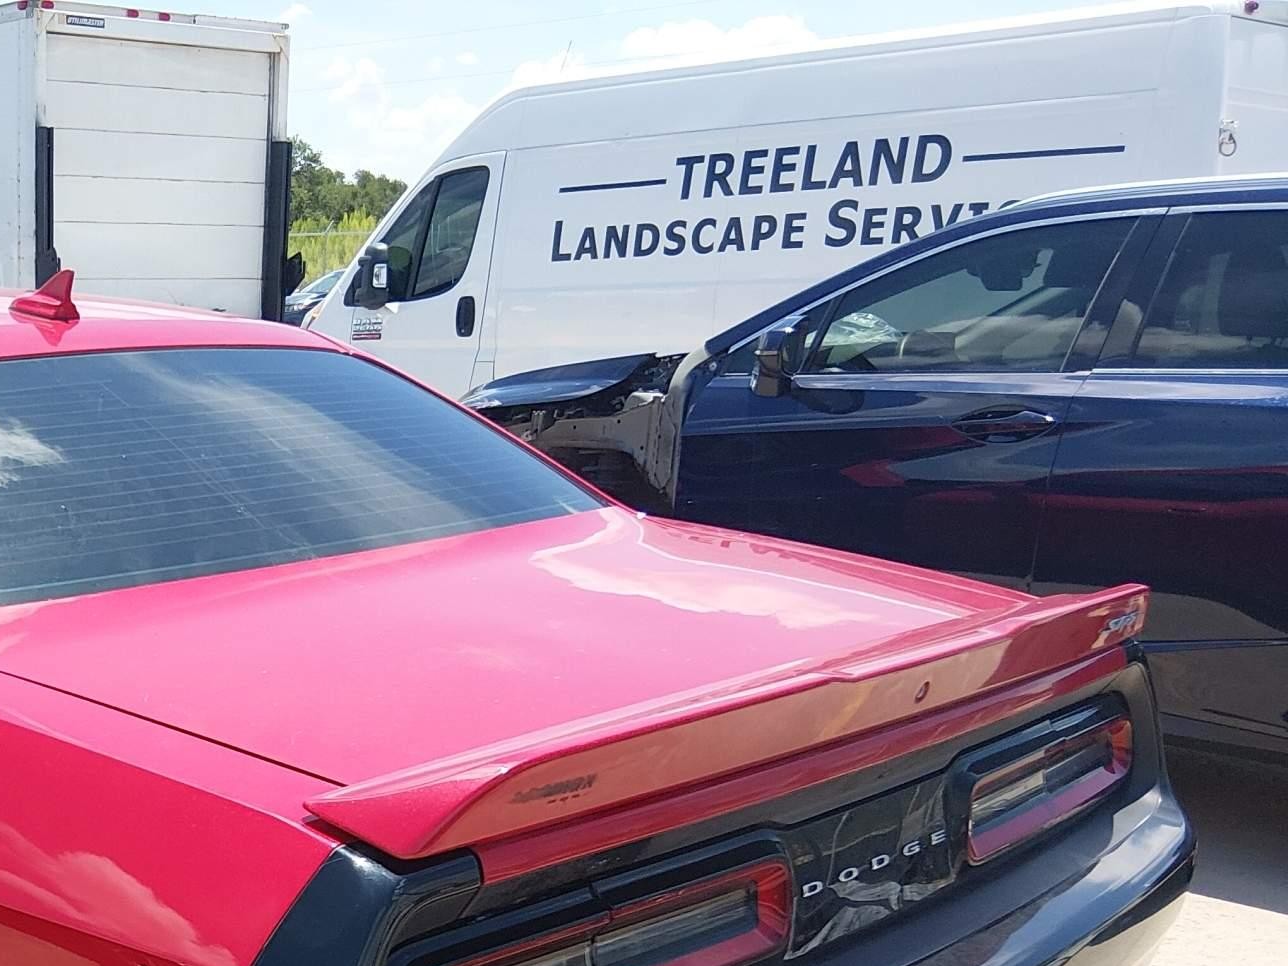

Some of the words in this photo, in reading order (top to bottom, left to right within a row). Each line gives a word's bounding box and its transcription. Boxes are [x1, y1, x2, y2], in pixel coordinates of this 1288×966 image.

[675, 133, 953, 200] TREELAND
[551, 212, 808, 262] LANDSCAPE
[824, 198, 1021, 247] SERV
[802, 829, 947, 898] DODGE
